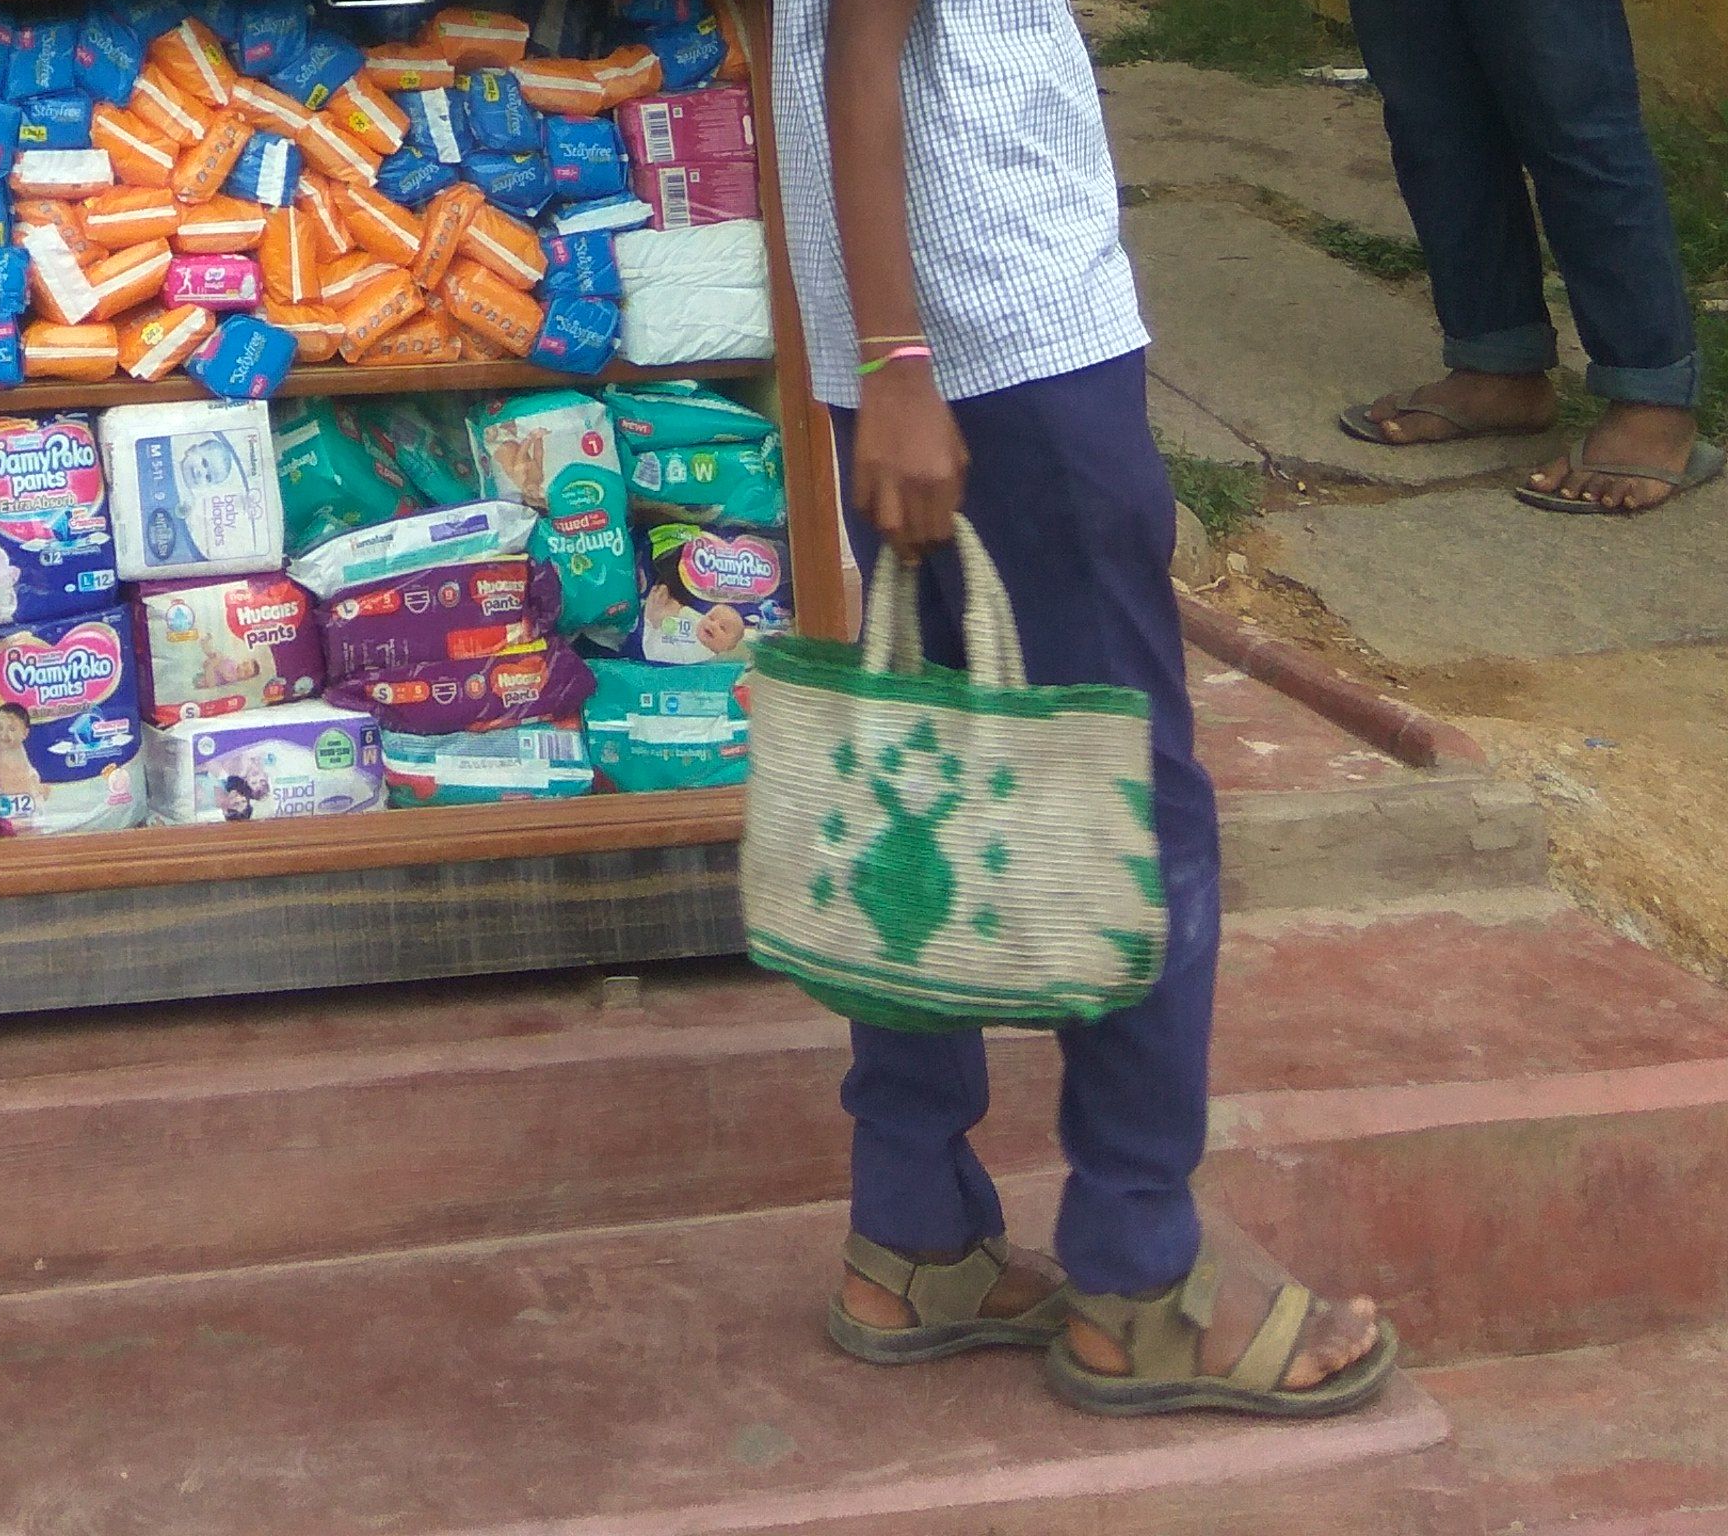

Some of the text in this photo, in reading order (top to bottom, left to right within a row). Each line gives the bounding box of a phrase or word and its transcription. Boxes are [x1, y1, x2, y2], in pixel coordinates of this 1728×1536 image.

[32, 103, 82, 120] Stayfree
[559, 141, 613, 161] Stayfree
[229, 330, 265, 384] Stayfree
[13, 470, 67, 497] pants
[211, 495, 226, 547] diapers
[223, 494, 239, 528] baby
[547, 527, 624, 557] Pampers
[245, 624, 297, 650] pants
[6, 648, 112, 692] MamyPoko
[40, 682, 84, 703] pants
[11, 795, 32, 812] 12
